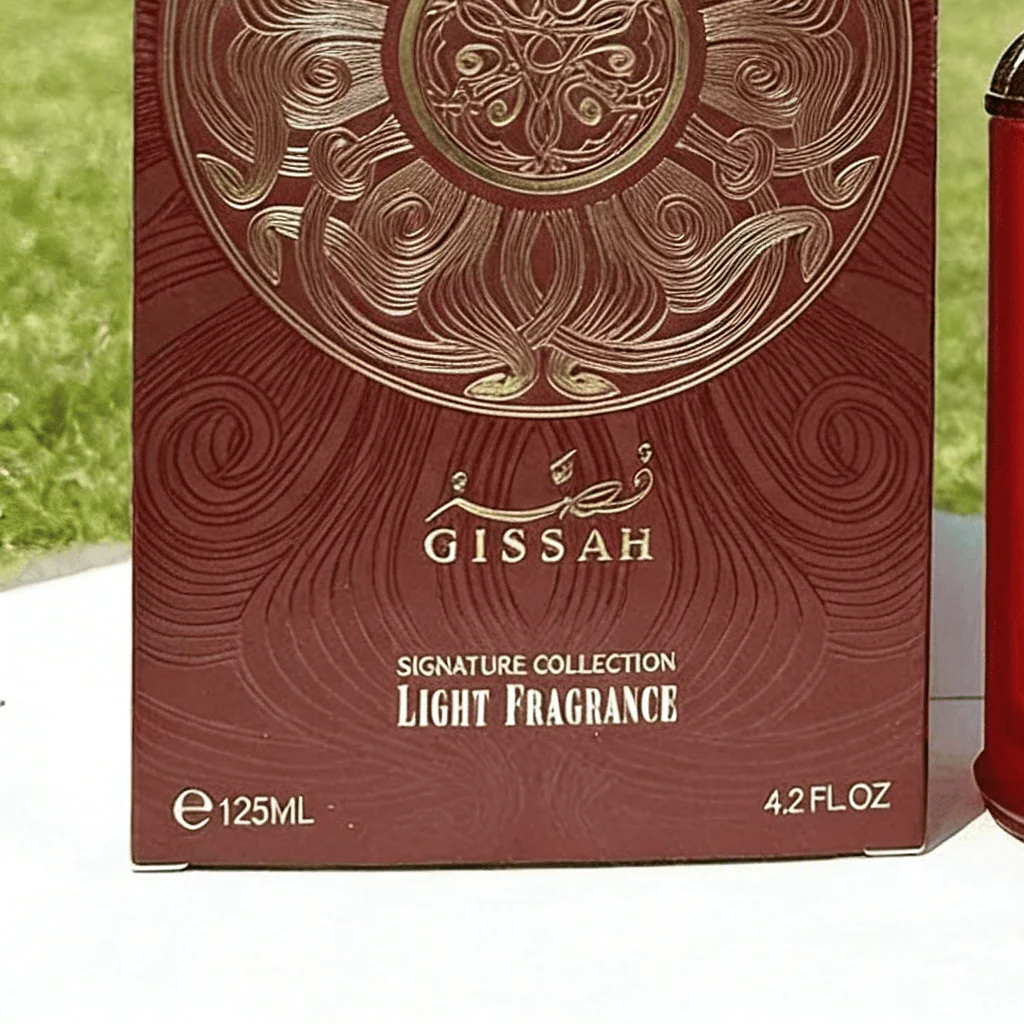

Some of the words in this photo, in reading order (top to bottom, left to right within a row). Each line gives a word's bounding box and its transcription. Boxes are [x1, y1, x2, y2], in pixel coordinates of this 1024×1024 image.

[423, 527, 654, 564] GISSAH
[396, 654, 527, 677] SIGNATURE
[532, 651, 677, 675] COLLECTION
[397, 684, 490, 727] LIGHT
[504, 683, 678, 727] FRAGRANCE
[219, 795, 315, 826] 125ML
